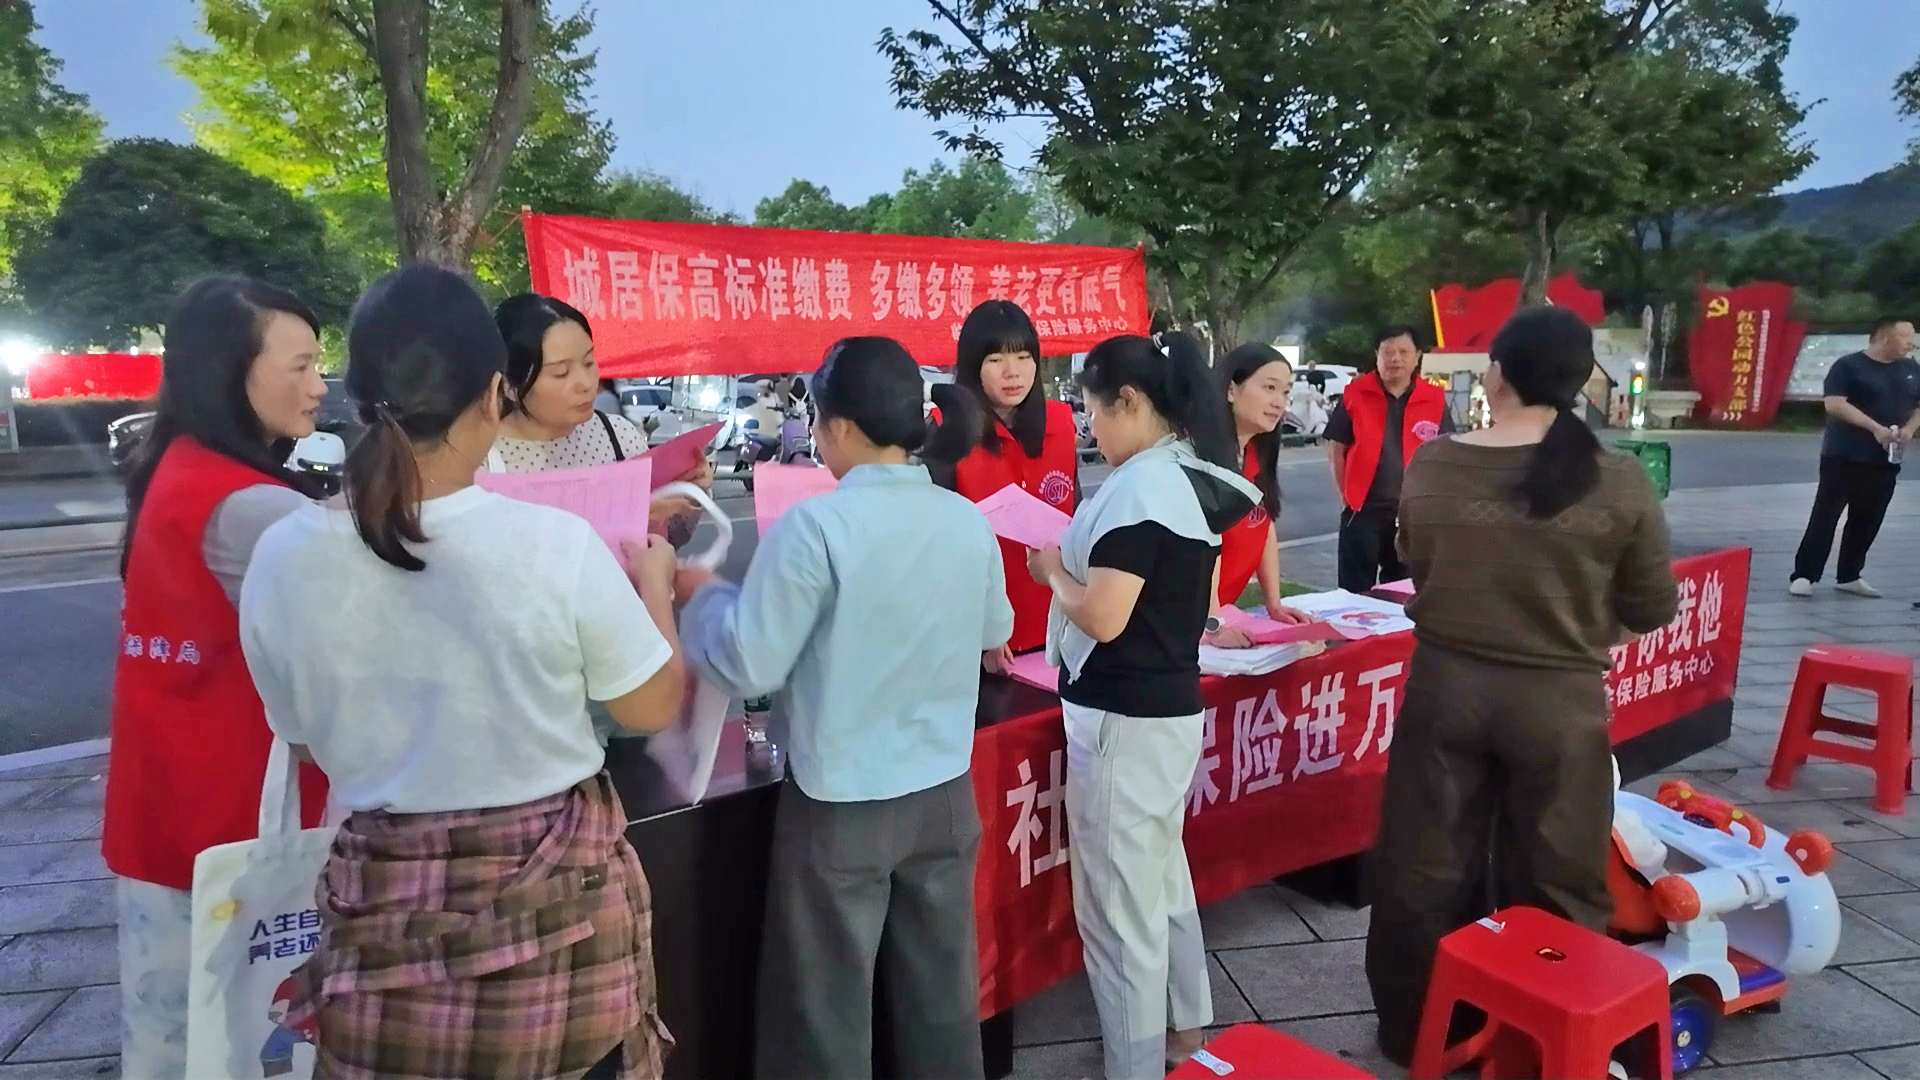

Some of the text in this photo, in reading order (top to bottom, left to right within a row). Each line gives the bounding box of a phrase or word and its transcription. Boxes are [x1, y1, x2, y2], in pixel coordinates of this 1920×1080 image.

[563, 246, 1126, 321] 城居保高标准缴费 多缴多领 养老更有底气
[951, 316, 1128, 341] 临保险服务中心
[1006, 661, 1404, 889] 社保险进万
[249, 909, 321, 941] 人生自
